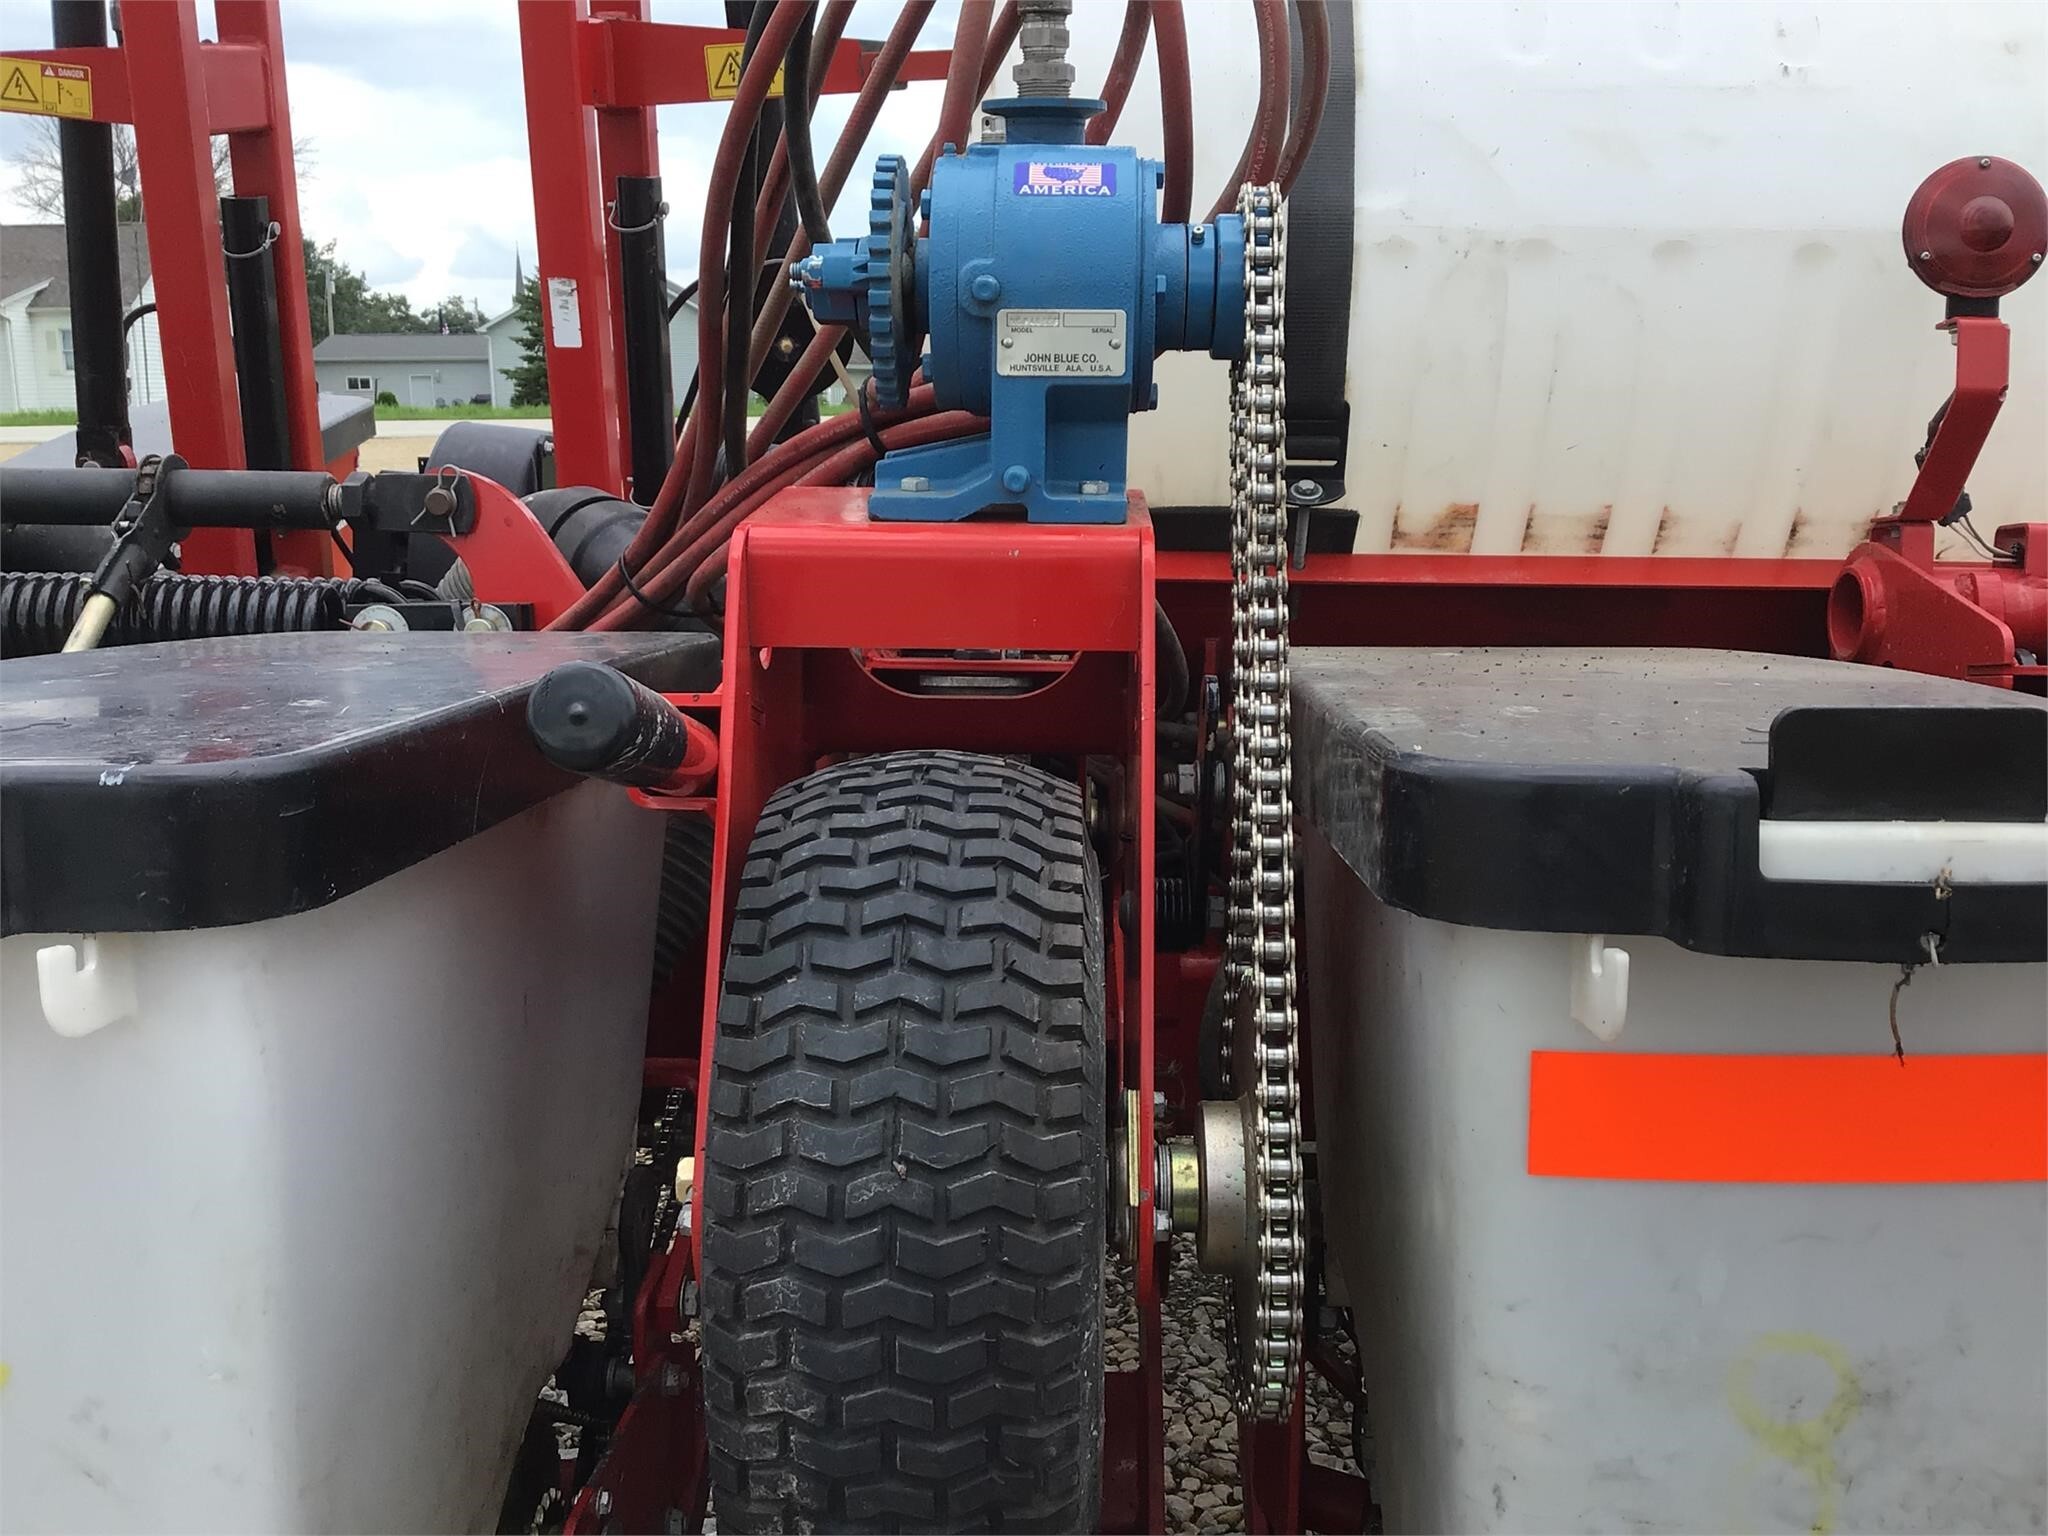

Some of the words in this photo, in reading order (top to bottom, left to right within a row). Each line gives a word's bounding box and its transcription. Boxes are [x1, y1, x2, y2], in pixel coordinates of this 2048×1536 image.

[57, 67, 85, 79] DANGER
[1019, 185, 1111, 195] AMERICA
[1024, 353, 1051, 363] JOHN
[1054, 353, 1079, 363] BLUE
[1081, 353, 1099, 363] CO.
[1009, 364, 1059, 372] HUNTSVILLE
